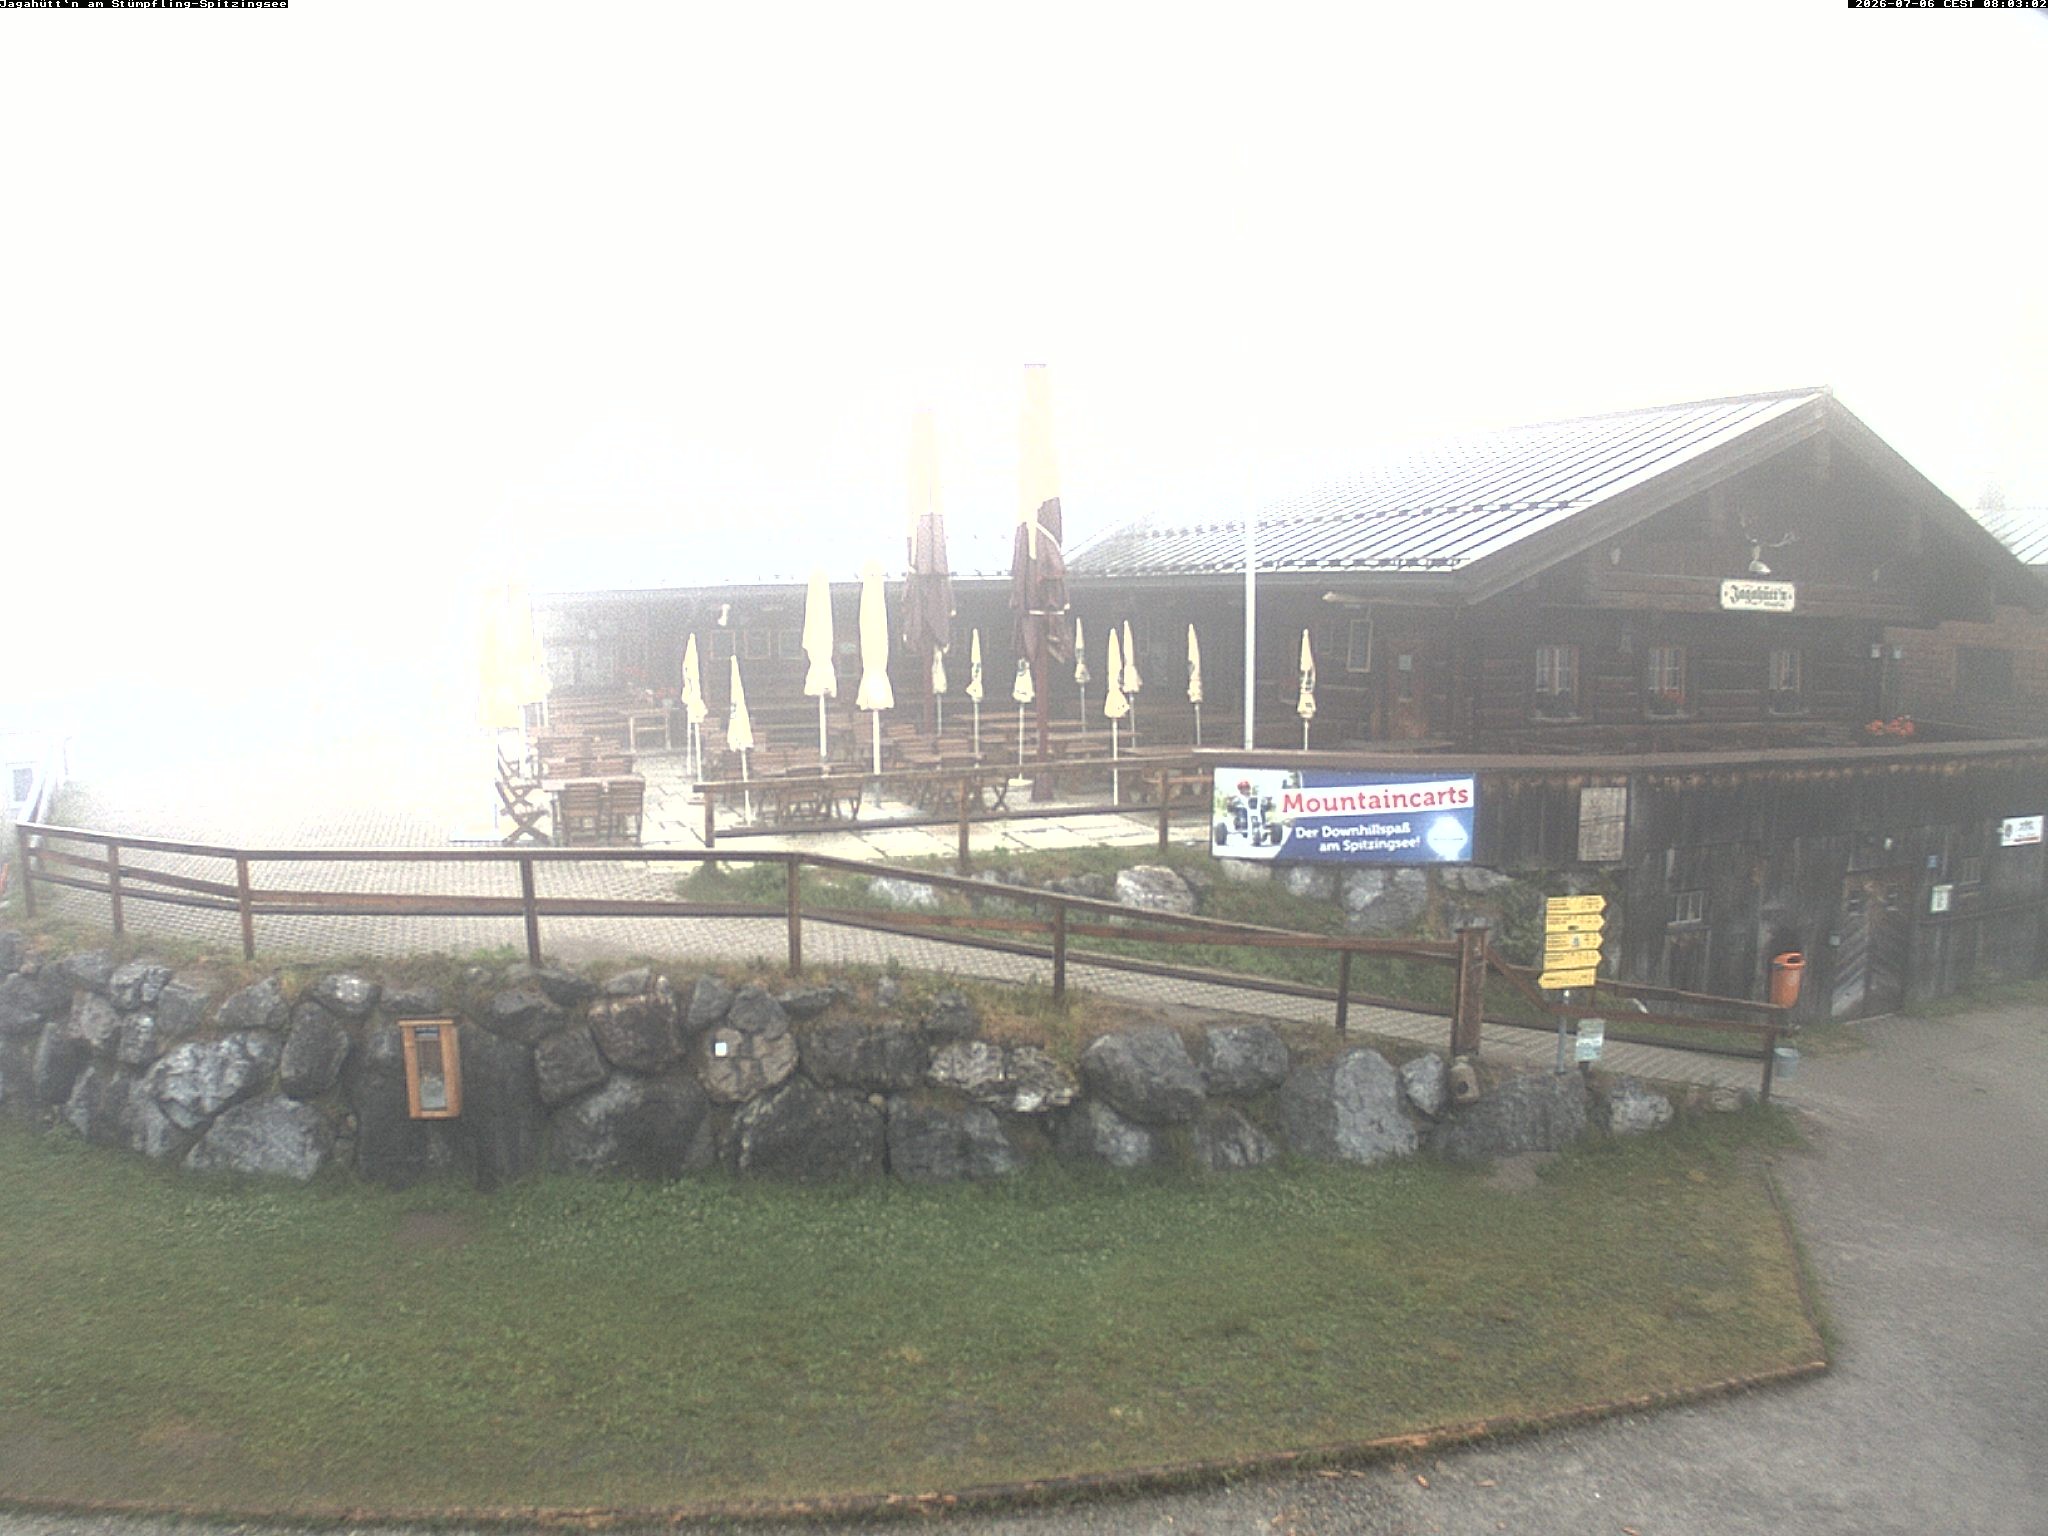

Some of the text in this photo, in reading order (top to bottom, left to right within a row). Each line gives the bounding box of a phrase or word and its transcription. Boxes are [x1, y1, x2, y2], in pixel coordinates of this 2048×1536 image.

[1282, 786, 1469, 813] Mountaincarts
[1295, 821, 1411, 839] Der Downhillspaß
[1319, 836, 1421, 853] am Spitzingsee!
